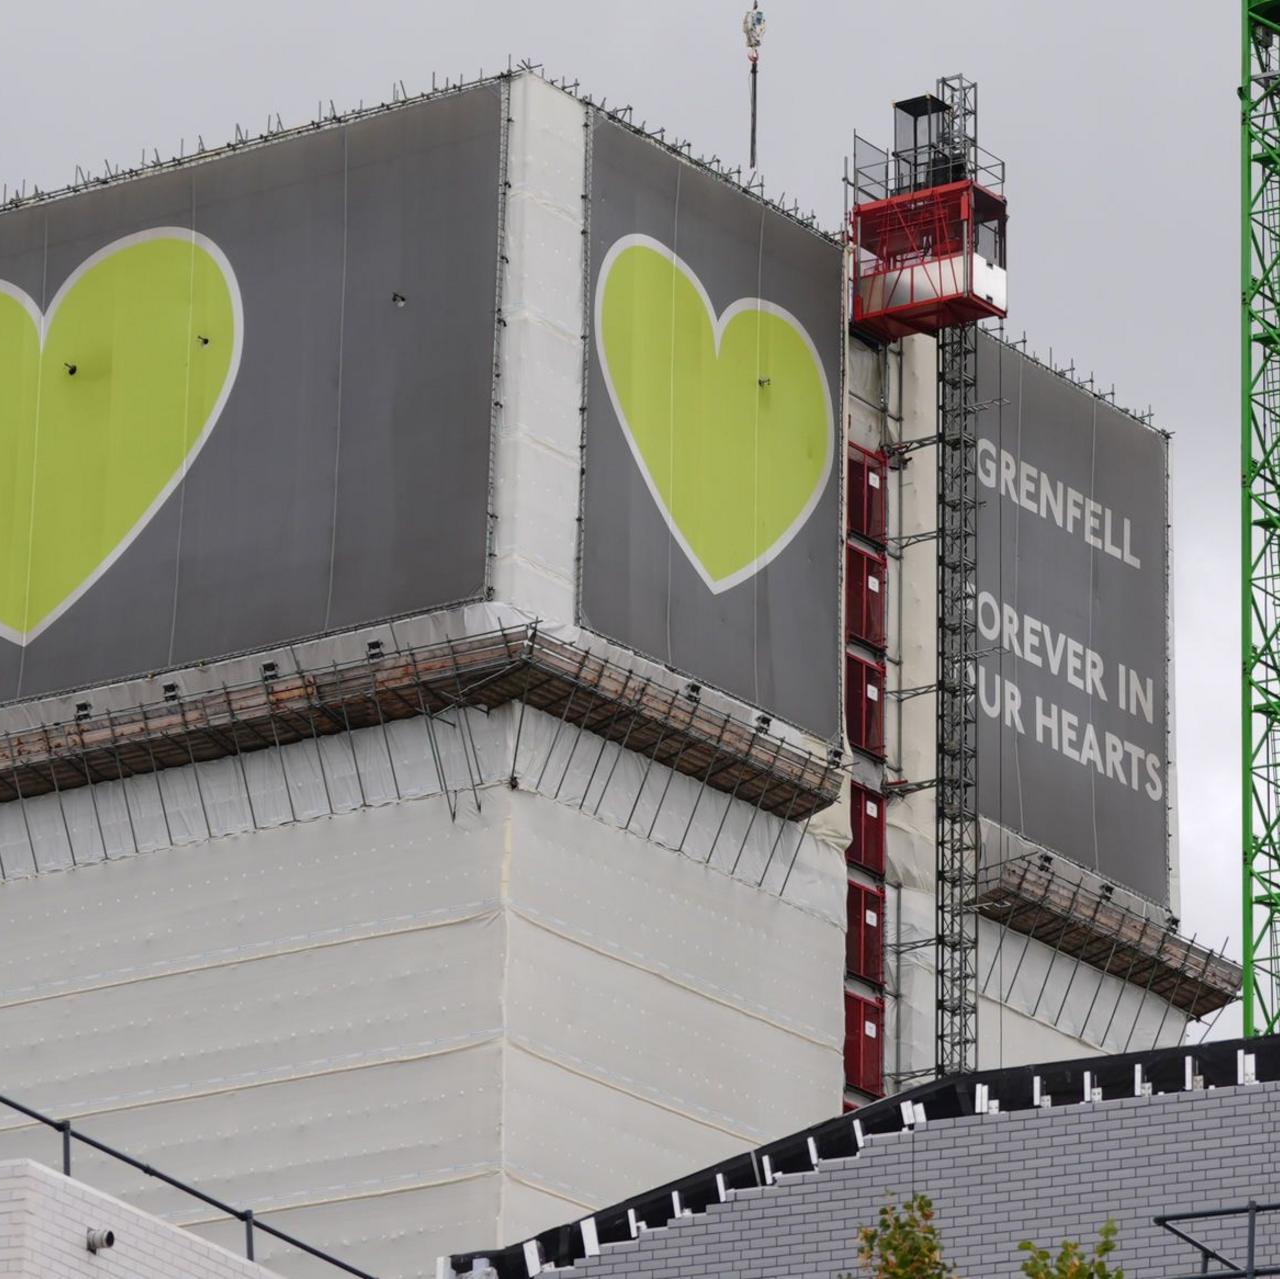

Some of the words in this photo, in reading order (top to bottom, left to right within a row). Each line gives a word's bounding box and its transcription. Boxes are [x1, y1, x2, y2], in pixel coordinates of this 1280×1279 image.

[977, 437, 1141, 569] GRENFELL
[1118, 662, 1154, 725] IN
[1035, 695, 1163, 802] HEARTS
